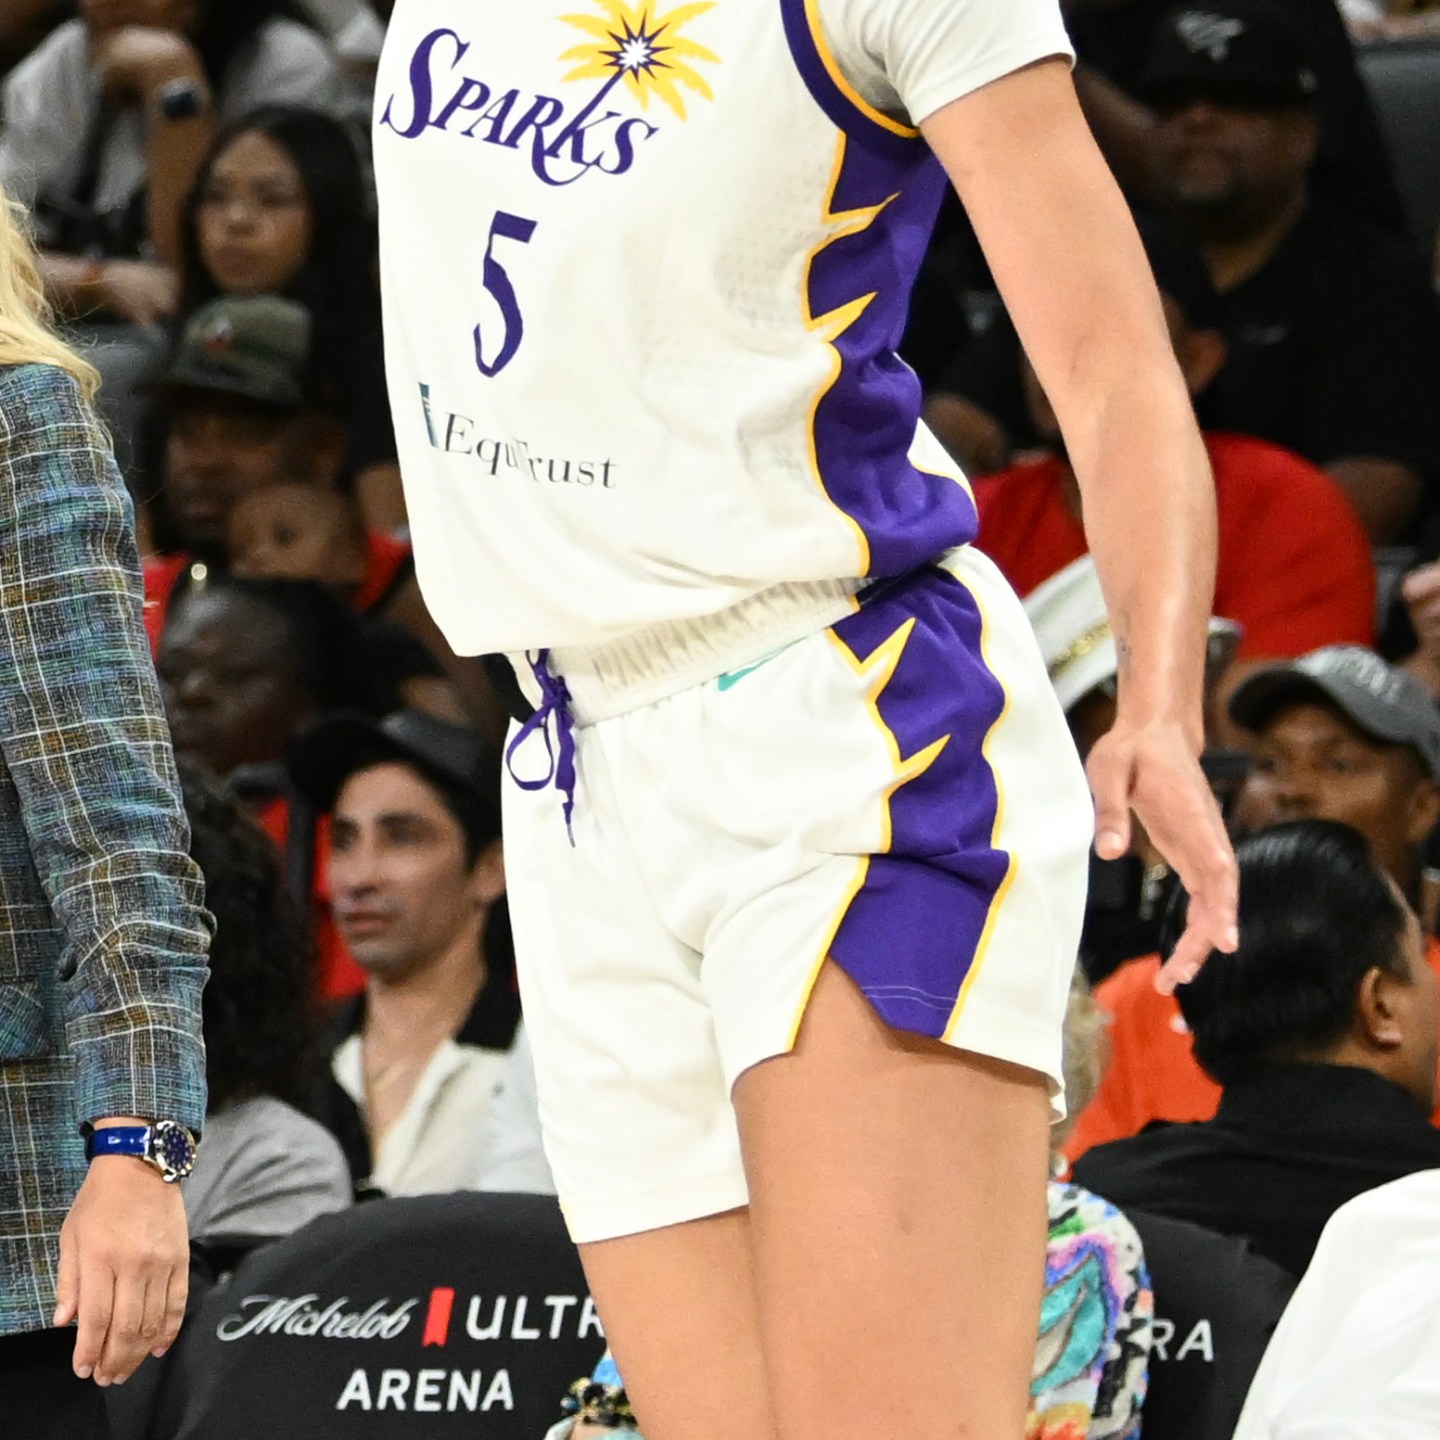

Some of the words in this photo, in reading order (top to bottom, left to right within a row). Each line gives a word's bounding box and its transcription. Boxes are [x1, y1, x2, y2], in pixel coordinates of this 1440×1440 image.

[473, 210, 538, 378] 5
[444, 412, 620, 489] EquTrust
[216, 1293, 419, 1342] Michelob
[466, 1294, 606, 1341] ULTR
[1148, 1318, 1214, 1362] RA
[336, 1368, 514, 1412] ARENA
